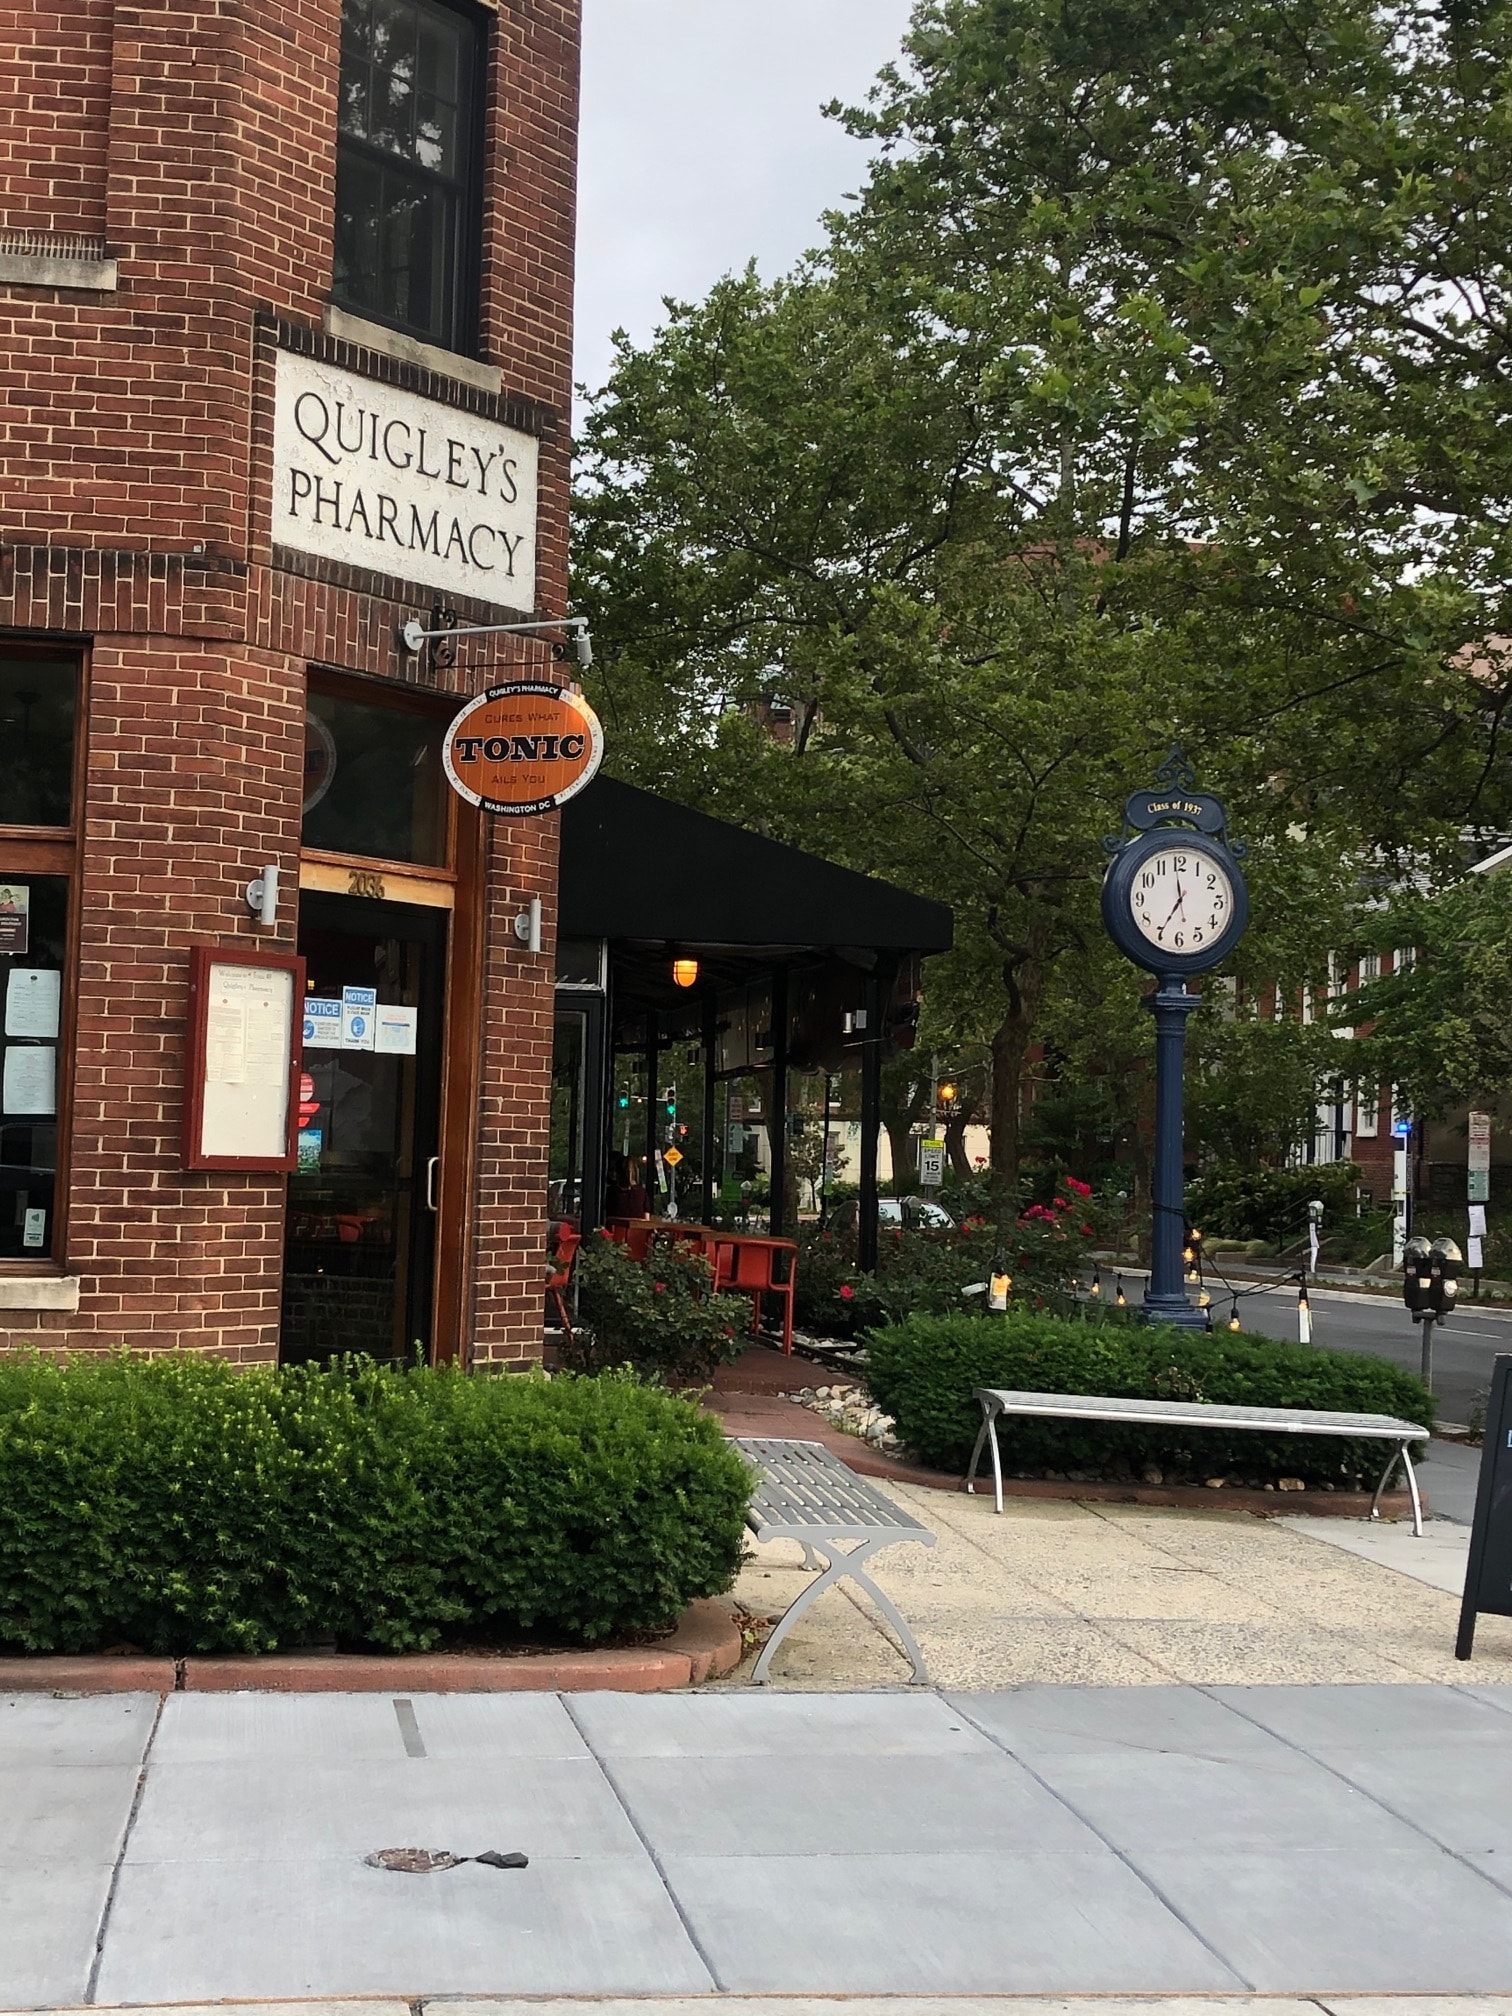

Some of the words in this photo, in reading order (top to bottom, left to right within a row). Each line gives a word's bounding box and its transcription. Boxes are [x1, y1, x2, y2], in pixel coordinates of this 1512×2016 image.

[294, 391, 518, 504] QUIGLEY'S
[288, 467, 524, 577] PHARMACY
[489, 685, 521, 697] QUIGLEY'S
[521, 684, 559, 695] PHARMACY
[484, 713, 523, 725] CURES
[527, 712, 561, 722] WHAT
[455, 734, 586, 763] TONIC
[491, 774, 517, 785] AILS
[522, 774, 546, 784] YOU
[484, 801, 537, 815] WASHINGTON
[538, 800, 551, 811] DC
[1147, 802, 1170, 814] Class
[1172, 800, 1182, 810] of
[1184, 802, 1203, 816] 1937
[1156, 859, 1166, 876] 11
[1173, 855, 1187, 873] 12
[1194, 861, 1200, 877] 1
[348, 870, 385, 899] 2036
[1142, 872, 1155, 889] 10
[1206, 873, 1217, 890] 2
[1135, 891, 1144, 908] 9
[1213, 894, 1224, 911] 3
[1141, 911, 1152, 927] 8
[1207, 914, 1218, 930] 4
[1156, 926, 1165, 942] 7
[1174, 931, 1184, 948] 6
[1192, 926, 1203, 943] 5
[345, 991, 374, 1003] NOTICE
[304, 1001, 339, 1016] NOTICE
[925, 1160, 940, 1172] 15
